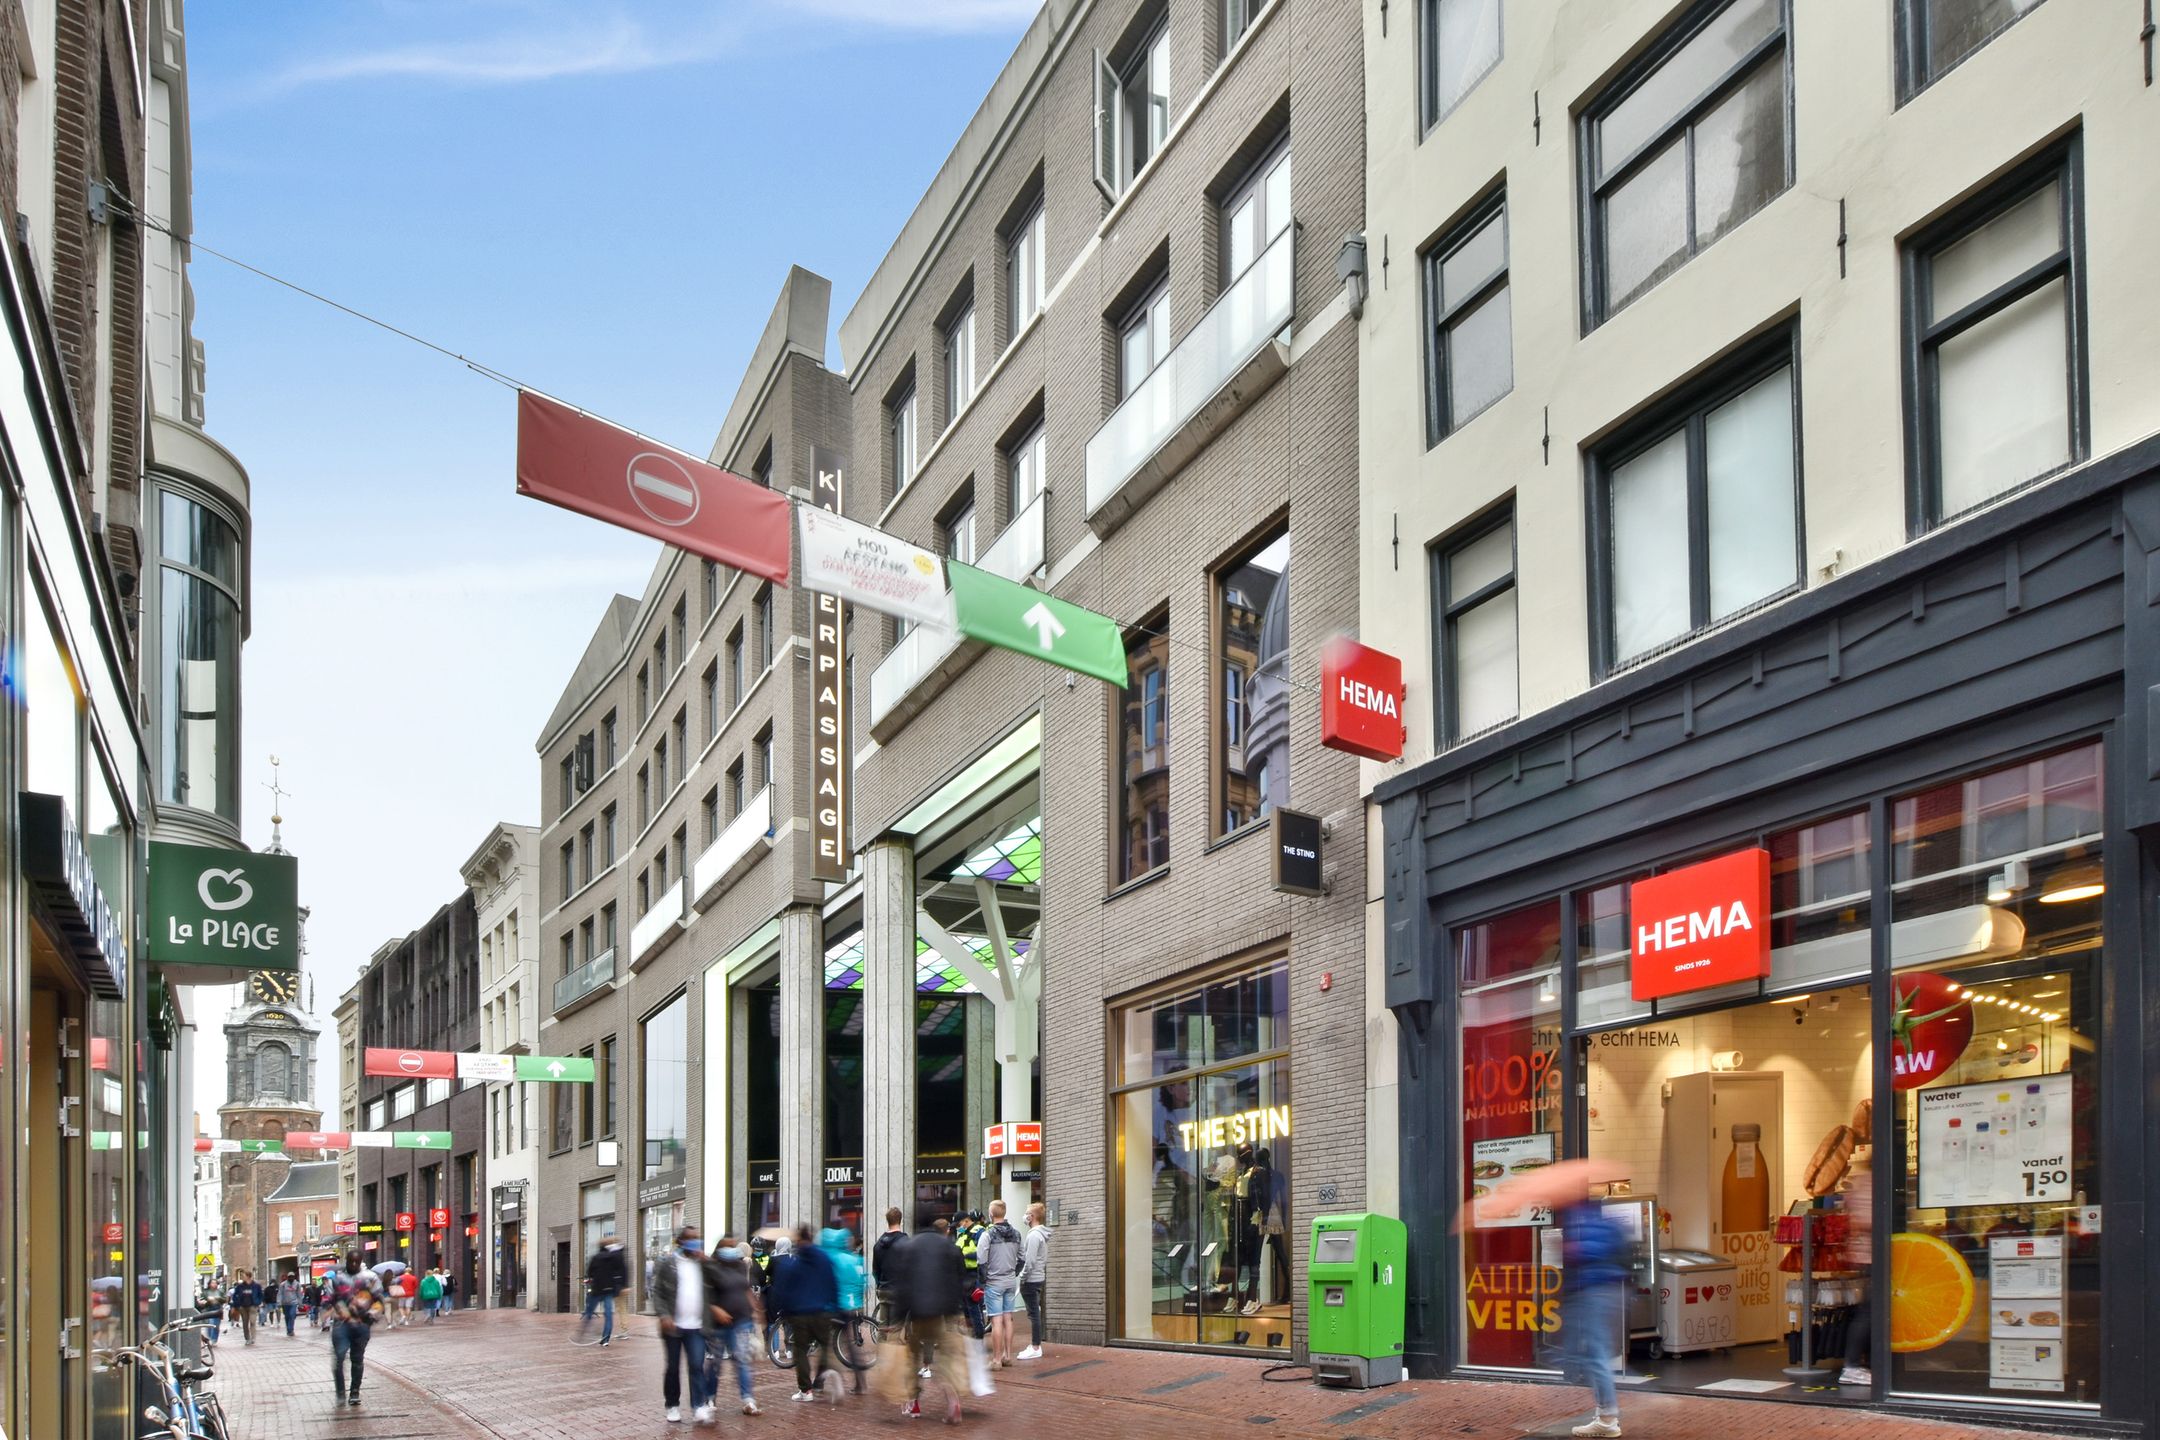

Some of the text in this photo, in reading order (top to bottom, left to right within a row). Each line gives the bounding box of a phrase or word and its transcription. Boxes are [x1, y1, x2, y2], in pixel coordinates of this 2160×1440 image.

[857, 538, 888, 555] HOU
[818, 470, 837, 858] KAERPASSAGE
[1340, 676, 1398, 719] HEMA
[1283, 845, 1315, 859] THE STING
[169, 916, 280, 950] La PLACE
[1638, 900, 1753, 956] HEMA
[1674, 959, 1711, 972] SINDS 1926
[1601, 1031, 1634, 1047] echt
[1638, 1031, 1680, 1047] HEMA
[1464, 1049, 1562, 1102] 100%
[1924, 1091, 1962, 1102] water
[1465, 1096, 1562, 1122] NATUURLIJK
[1016, 1132, 1040, 1142] HEMA
[1178, 1104, 1290, 1152] THE STIN
[2022, 1156, 2064, 1167] vanaf
[1721, 1234, 1770, 1254] 100%
[1466, 1265, 1563, 1294] ALTIJD
[1736, 1268, 1770, 1291] uitig
[1740, 1293, 1770, 1306] VERS
[1466, 1299, 1563, 1333] VERS
